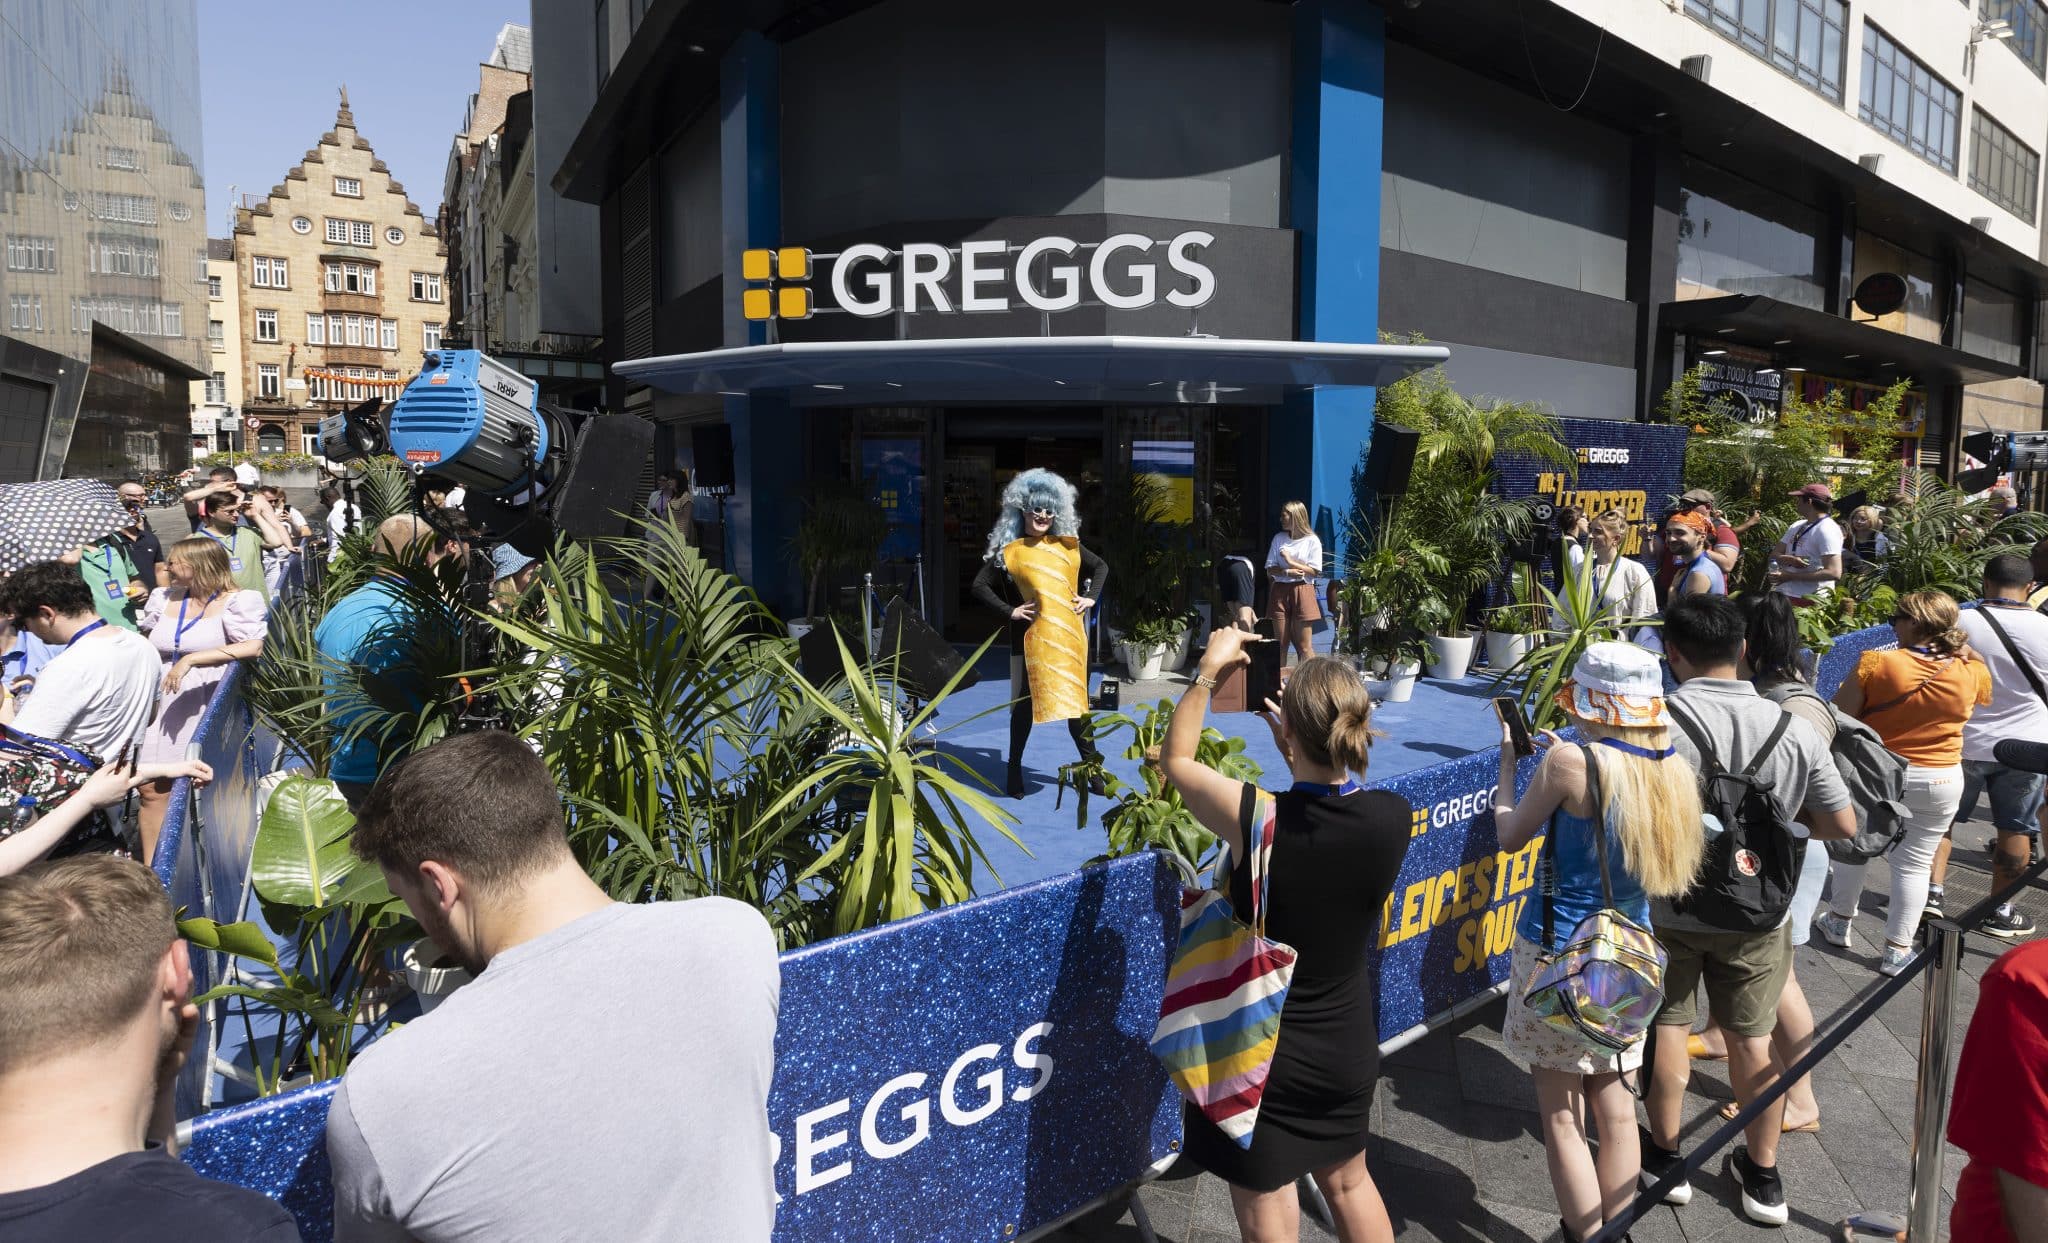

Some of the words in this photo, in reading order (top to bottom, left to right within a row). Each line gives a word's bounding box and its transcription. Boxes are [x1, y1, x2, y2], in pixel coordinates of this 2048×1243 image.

[831, 231, 1217, 317] GREGGS
[497, 381, 518, 398] ARRI
[1727, 365, 1746, 383] FOOD
[1755, 372, 1781, 388] DRINKS
[1589, 448, 1630, 464] GREGGS
[1432, 785, 1499, 828] GREG
[769, 1022, 1054, 1203] EGGS
